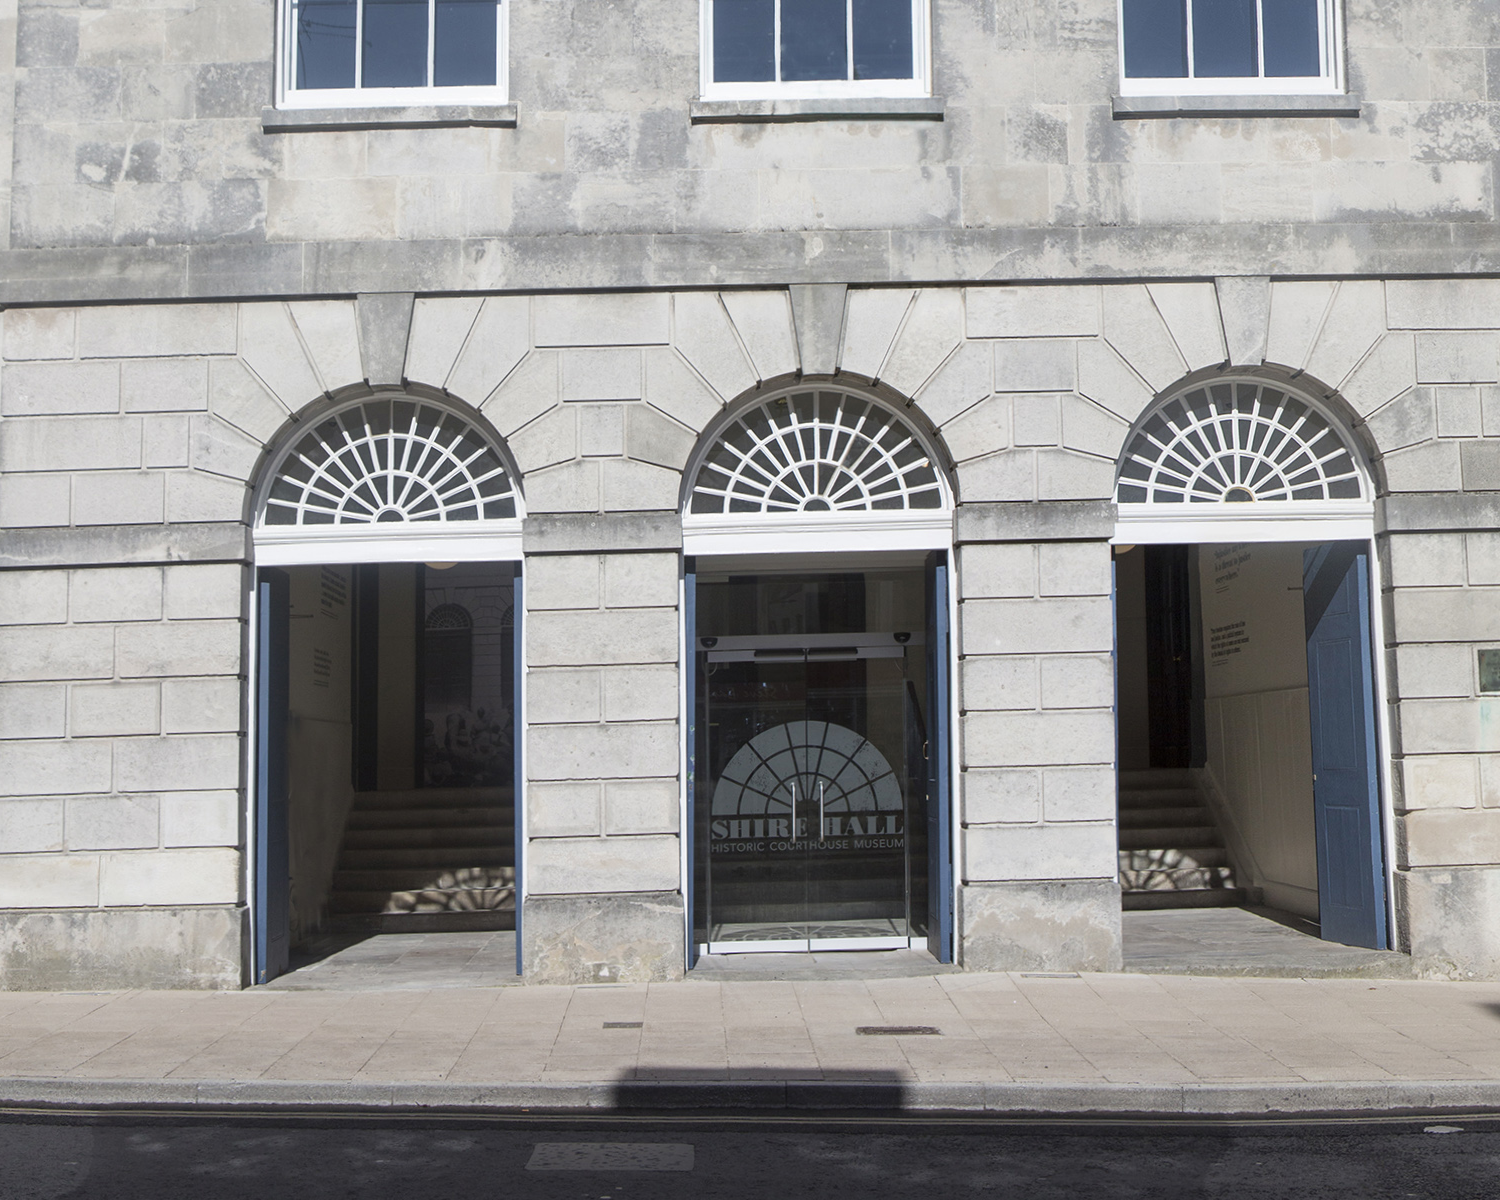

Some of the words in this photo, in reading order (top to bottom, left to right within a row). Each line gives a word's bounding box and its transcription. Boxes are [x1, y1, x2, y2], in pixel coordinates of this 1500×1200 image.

[711, 817, 808, 840] SHIRE
[822, 815, 904, 836] HALL
[711, 842, 765, 853] HISTORIC
[769, 839, 849, 851] COURTHOUSE
[854, 838, 905, 848] MUSEUM
